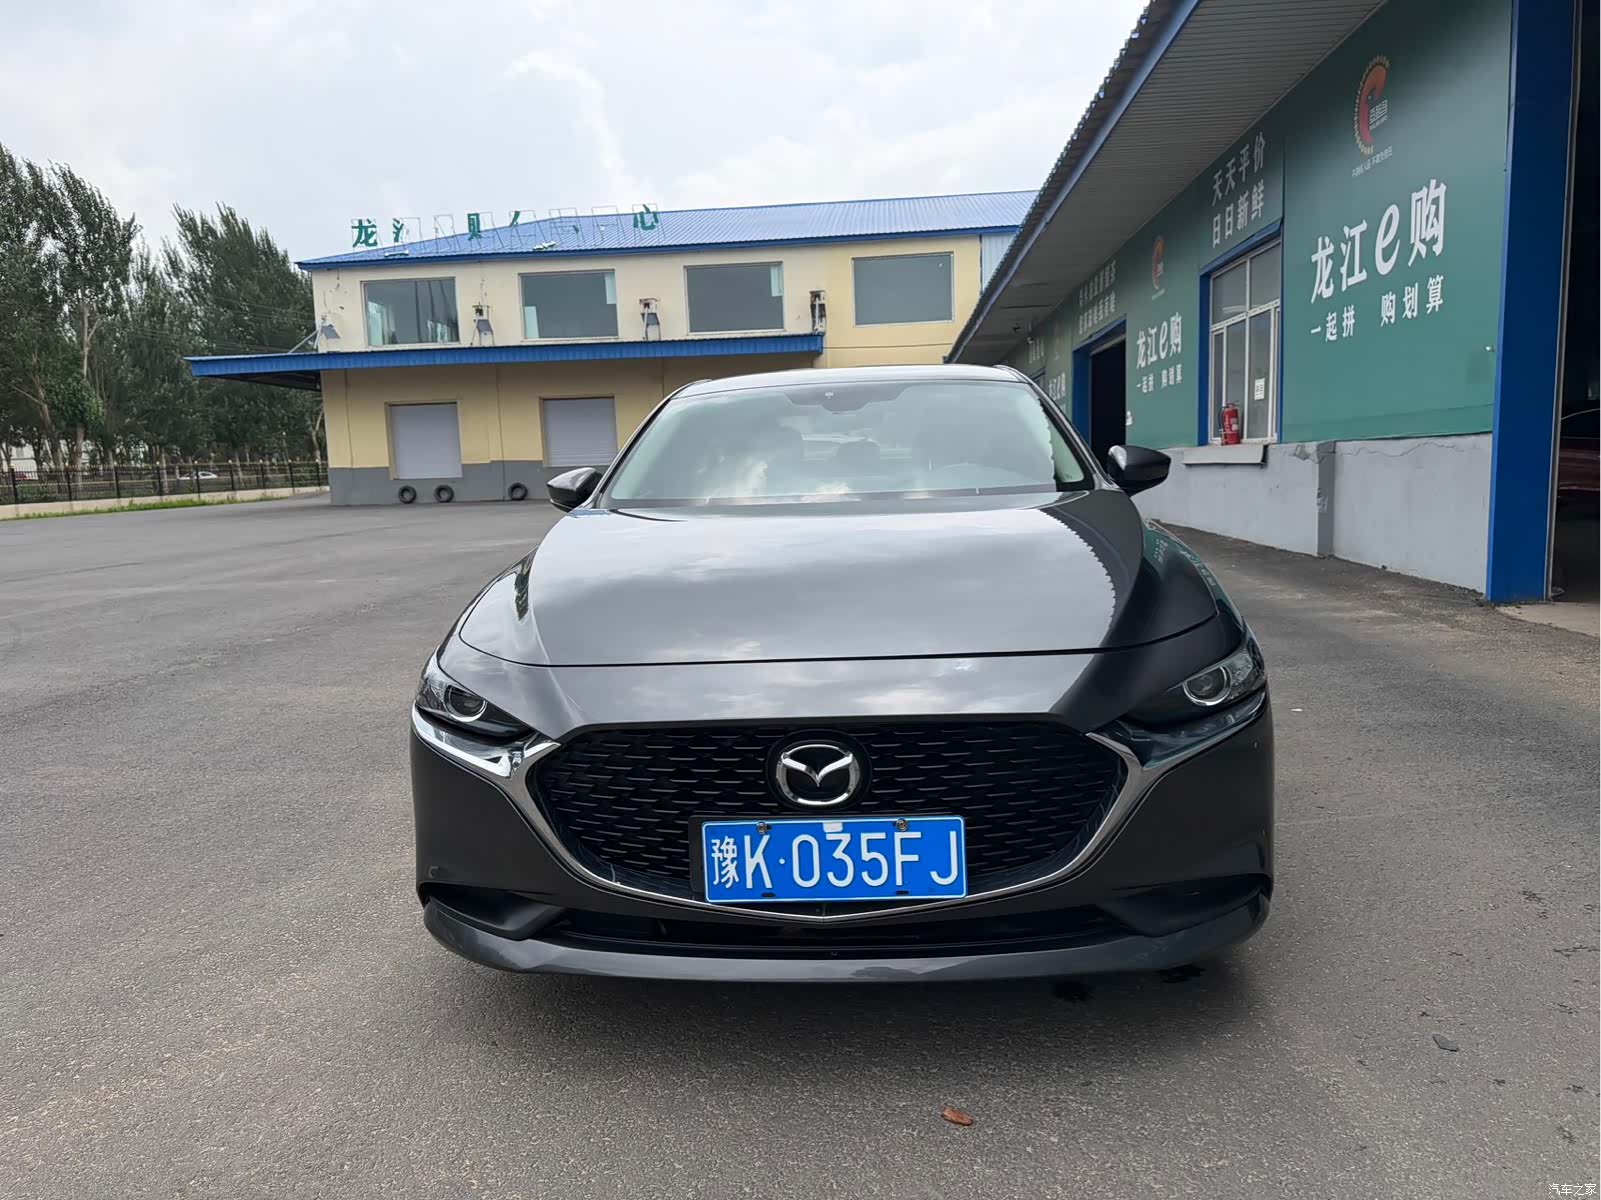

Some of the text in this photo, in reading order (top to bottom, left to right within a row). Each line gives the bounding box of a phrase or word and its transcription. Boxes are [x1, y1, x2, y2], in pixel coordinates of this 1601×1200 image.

[1212, 131, 1265, 207] 天天平价
[1212, 179, 1264, 248] 日日新鲜
[1310, 179, 1447, 304] 龙江e购
[1136, 311, 1182, 369] 龙江e购
[1310, 274, 1445, 342] 一起拼 购划算
